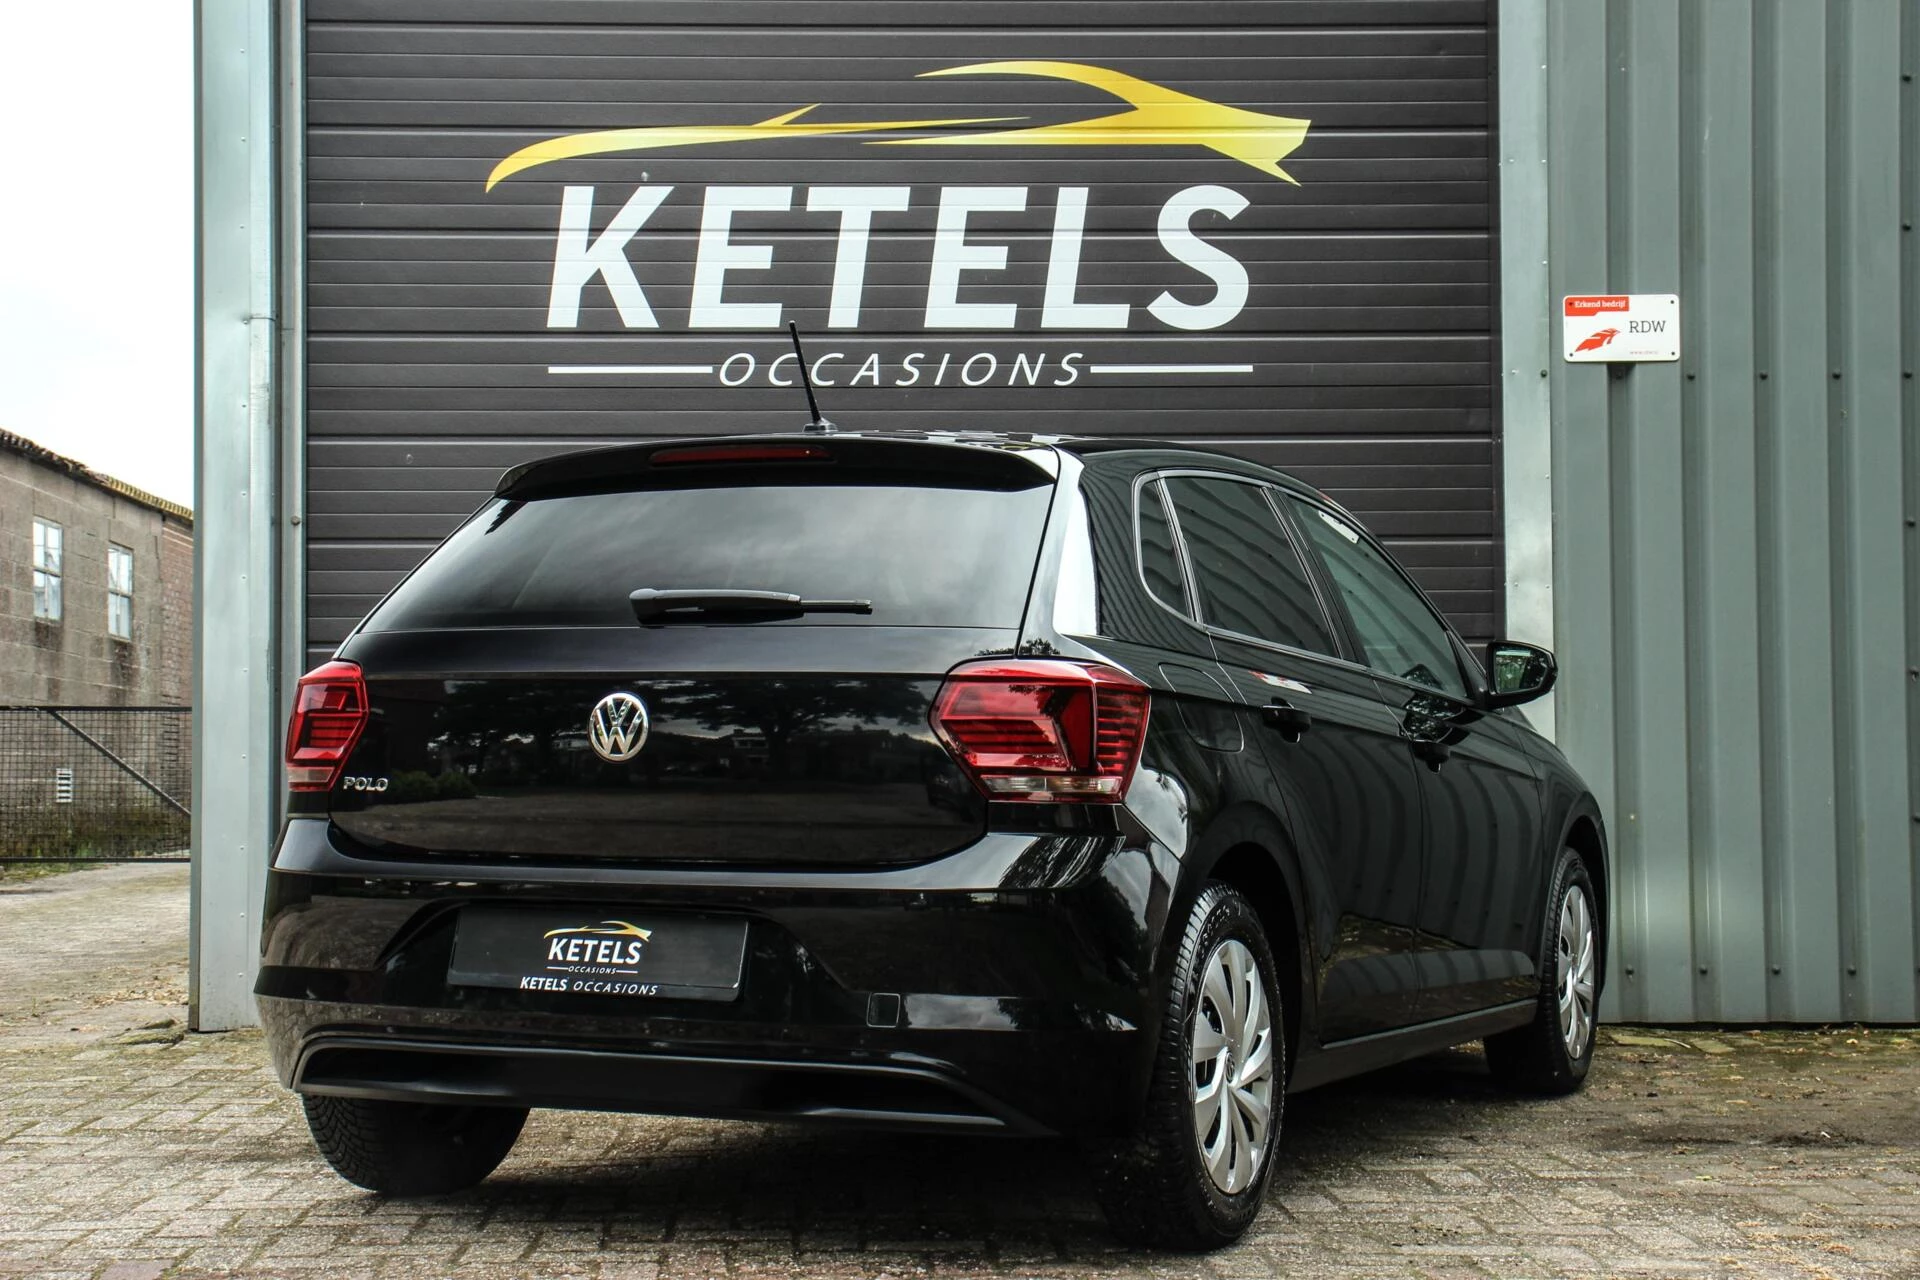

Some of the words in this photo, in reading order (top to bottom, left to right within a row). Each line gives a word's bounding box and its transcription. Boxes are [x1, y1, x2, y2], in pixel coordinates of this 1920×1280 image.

[547, 185, 1251, 330] KETELS
[1629, 320, 1666, 333] RDW
[719, 352, 1084, 386] OCCASIONS
[343, 776, 389, 791] POLO
[548, 938, 642, 964] KETELS
[568, 965, 617, 974] OCCASIONS
[520, 976, 568, 991] KETELS
[573, 981, 658, 996] OCCASIONS
